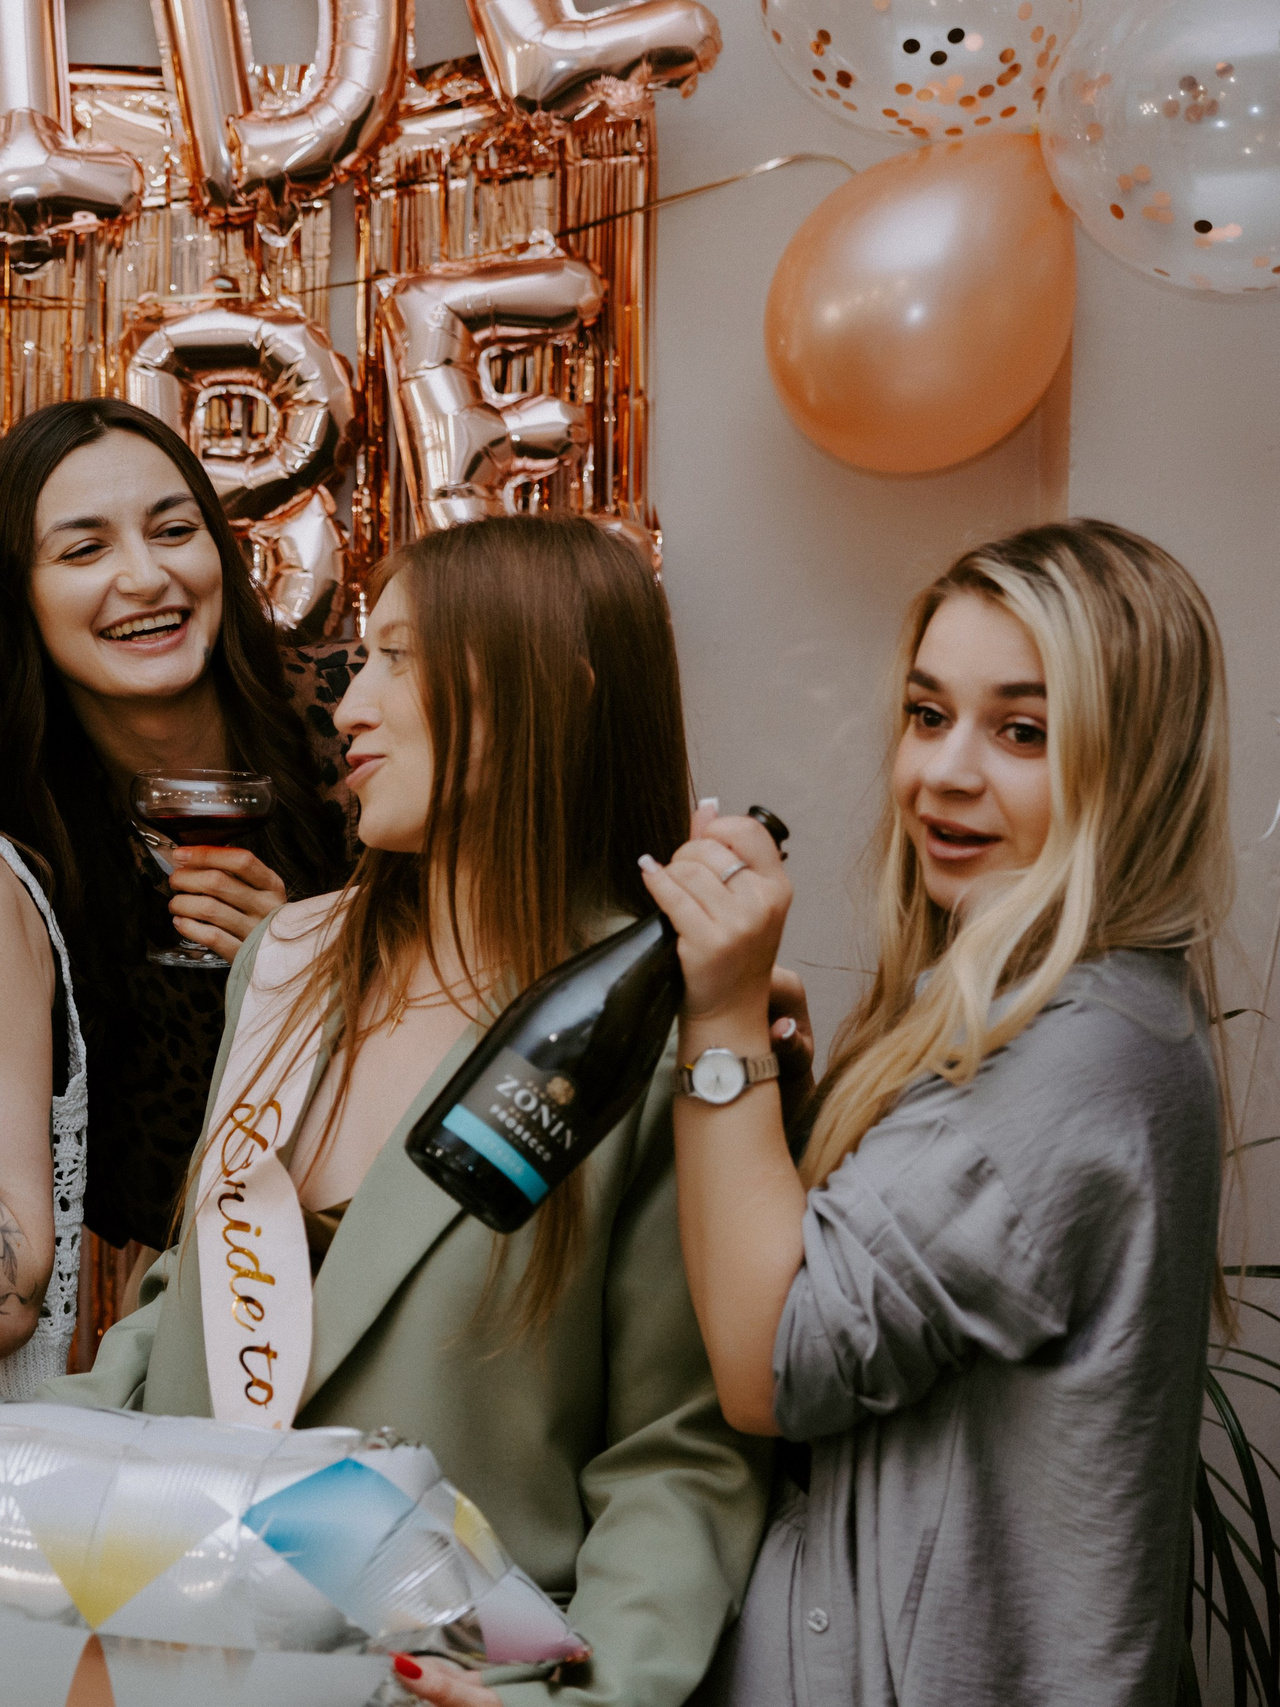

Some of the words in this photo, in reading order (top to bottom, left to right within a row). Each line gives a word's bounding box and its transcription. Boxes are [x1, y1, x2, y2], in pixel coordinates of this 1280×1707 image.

[488, 1103, 552, 1163] PROSECCO
[494, 1073, 579, 1150] ZONIN
[218, 1099, 282, 1333] Bride
[238, 1341, 278, 1411] to
